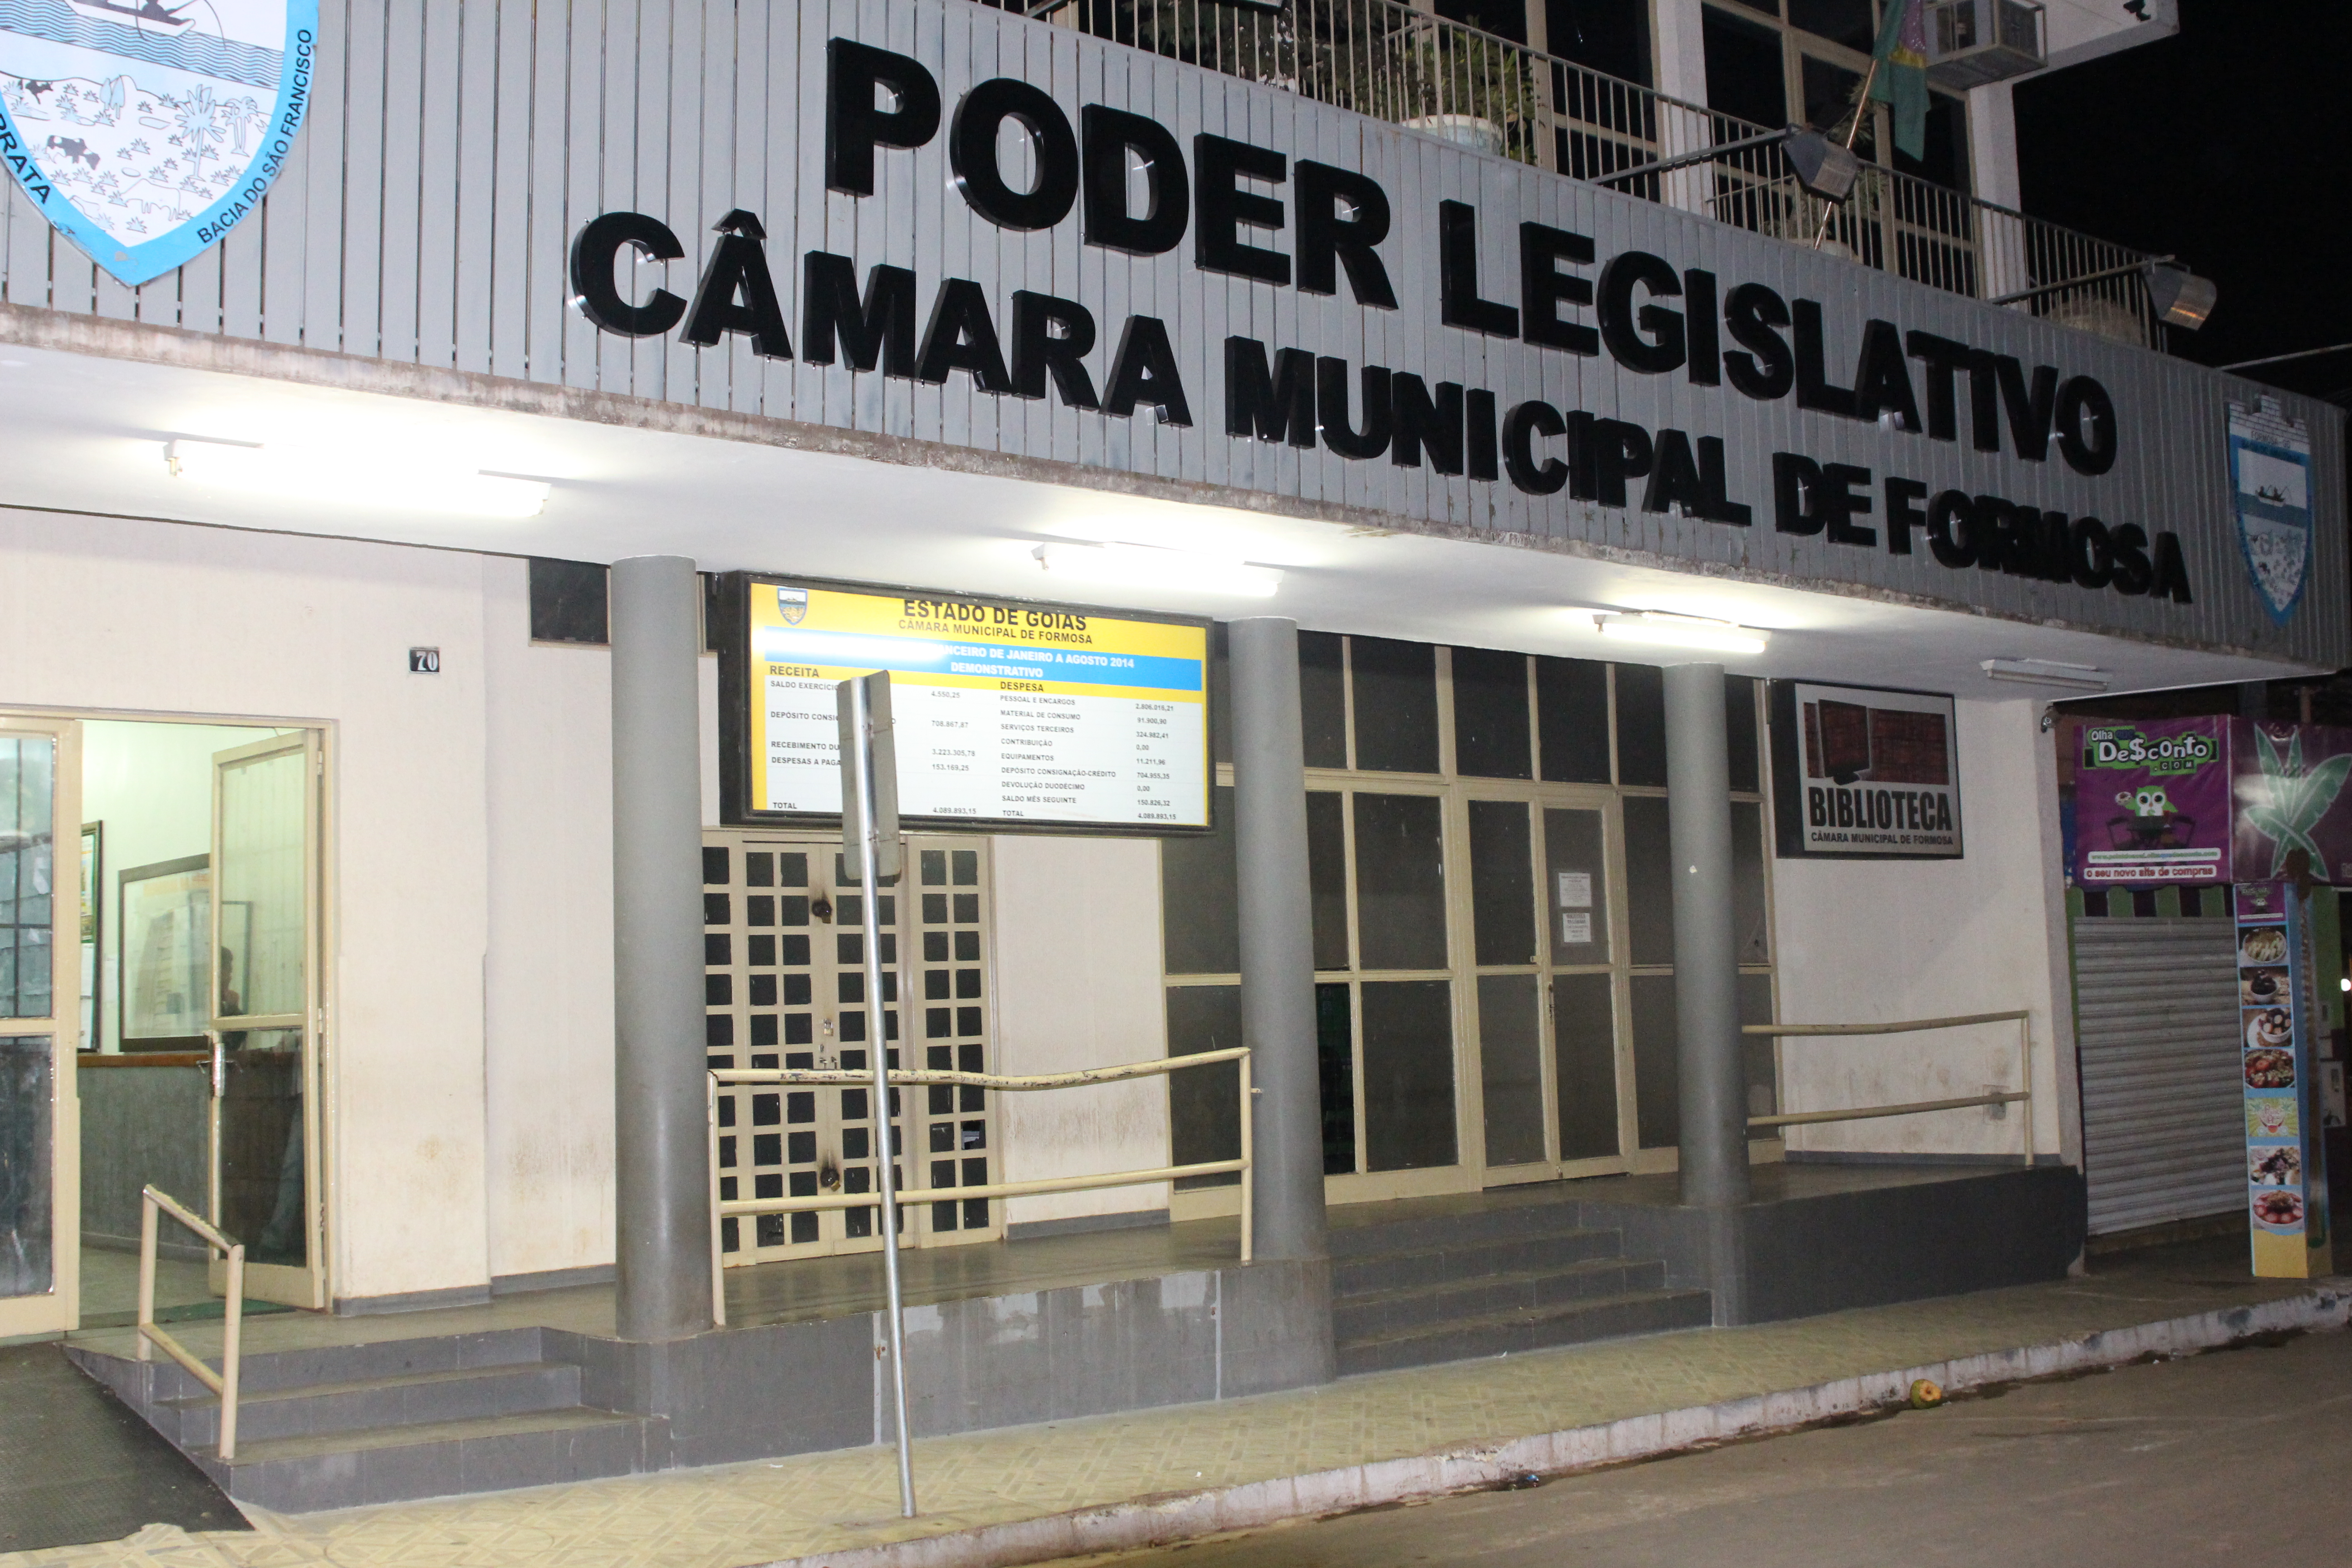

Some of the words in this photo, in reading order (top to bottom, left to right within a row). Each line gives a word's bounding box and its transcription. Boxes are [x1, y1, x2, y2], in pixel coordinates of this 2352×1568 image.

[197, 203, 249, 244] BACIA
[248, 176, 268, 201] DO
[267, 140, 289, 177] SÃO
[282, 29, 312, 136] FRANCISCO
[825, 37, 1399, 310] PODER
[1440, 199, 2117, 475] LEGISLATIVO
[570, 209, 1193, 428] CÂMARA
[1224, 335, 1752, 527] MUNICIPAL
[1772, 451, 1877, 546] DE
[1884, 475, 2193, 604] FORMOSA
[904, 599, 985, 622] ESTADO
[994, 607, 1019, 626] DE
[899, 618, 950, 632] CÂMARA
[953, 623, 1017, 638] MUNICIPAL
[1020, 629, 1035, 639] DE
[1039, 631, 1093, 644] FORMOSA
[416, 651, 439, 671] 70
[989, 648, 1005, 659] DE
[1006, 650, 1054, 662] JANEIRO
[1055, 653, 1063, 663] A
[1065, 654, 1108, 666] AGOSTO
[1110, 656, 1135, 668] 2014
[769, 665, 819, 678] RECEITA
[950, 662, 1044, 678] DEMONSTRATIVO
[770, 680, 796, 688] SALDO
[1000, 681, 1044, 692] DESPESA
[770, 710, 809, 720] DEPÓSITO
[2091, 730, 2113, 741] Olha
[771, 741, 827, 750] RECEBIMENTO
[1001, 738, 1053, 747] CONTRIBUIÇÃO
[932, 749, 975, 757] 3.223.305,78
[771, 757, 811, 765] DESPESAS
[1001, 781, 1043, 789] DEVOLUÇÃO
[1808, 786, 1953, 831] BIBLIOTECA
[1811, 830, 1849, 842] CÂMARA
[1851, 833, 1898, 844] MUNICIPAL
[1900, 835, 1912, 844] DE
[1913, 835, 1953, 845] FORMOSA
[2158, 867, 2170, 876] de
[2172, 867, 2214, 878] compras
